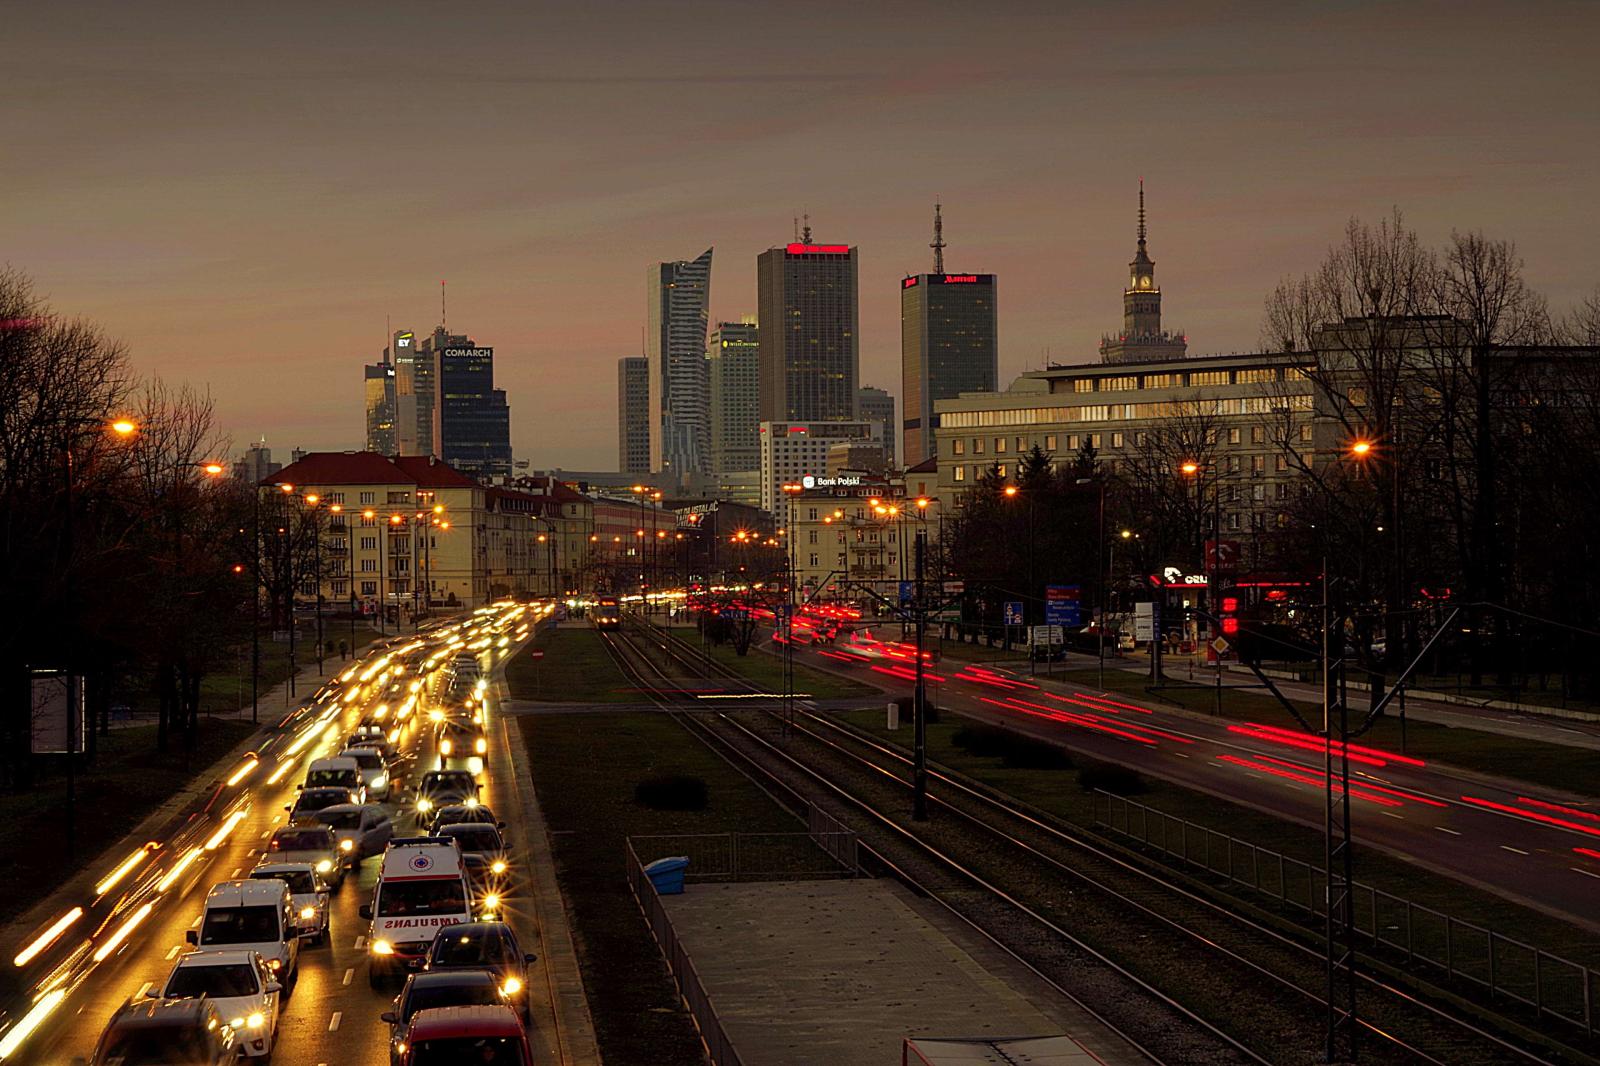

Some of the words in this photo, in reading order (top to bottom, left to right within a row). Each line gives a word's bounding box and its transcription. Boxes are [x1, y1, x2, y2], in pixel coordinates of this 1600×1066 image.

[398, 339, 410, 347] EY
[445, 349, 490, 357] COMARCH
[818, 477, 836, 486] Bank
[837, 476, 860, 486] Polski
[1184, 575, 1208, 584] ORL
